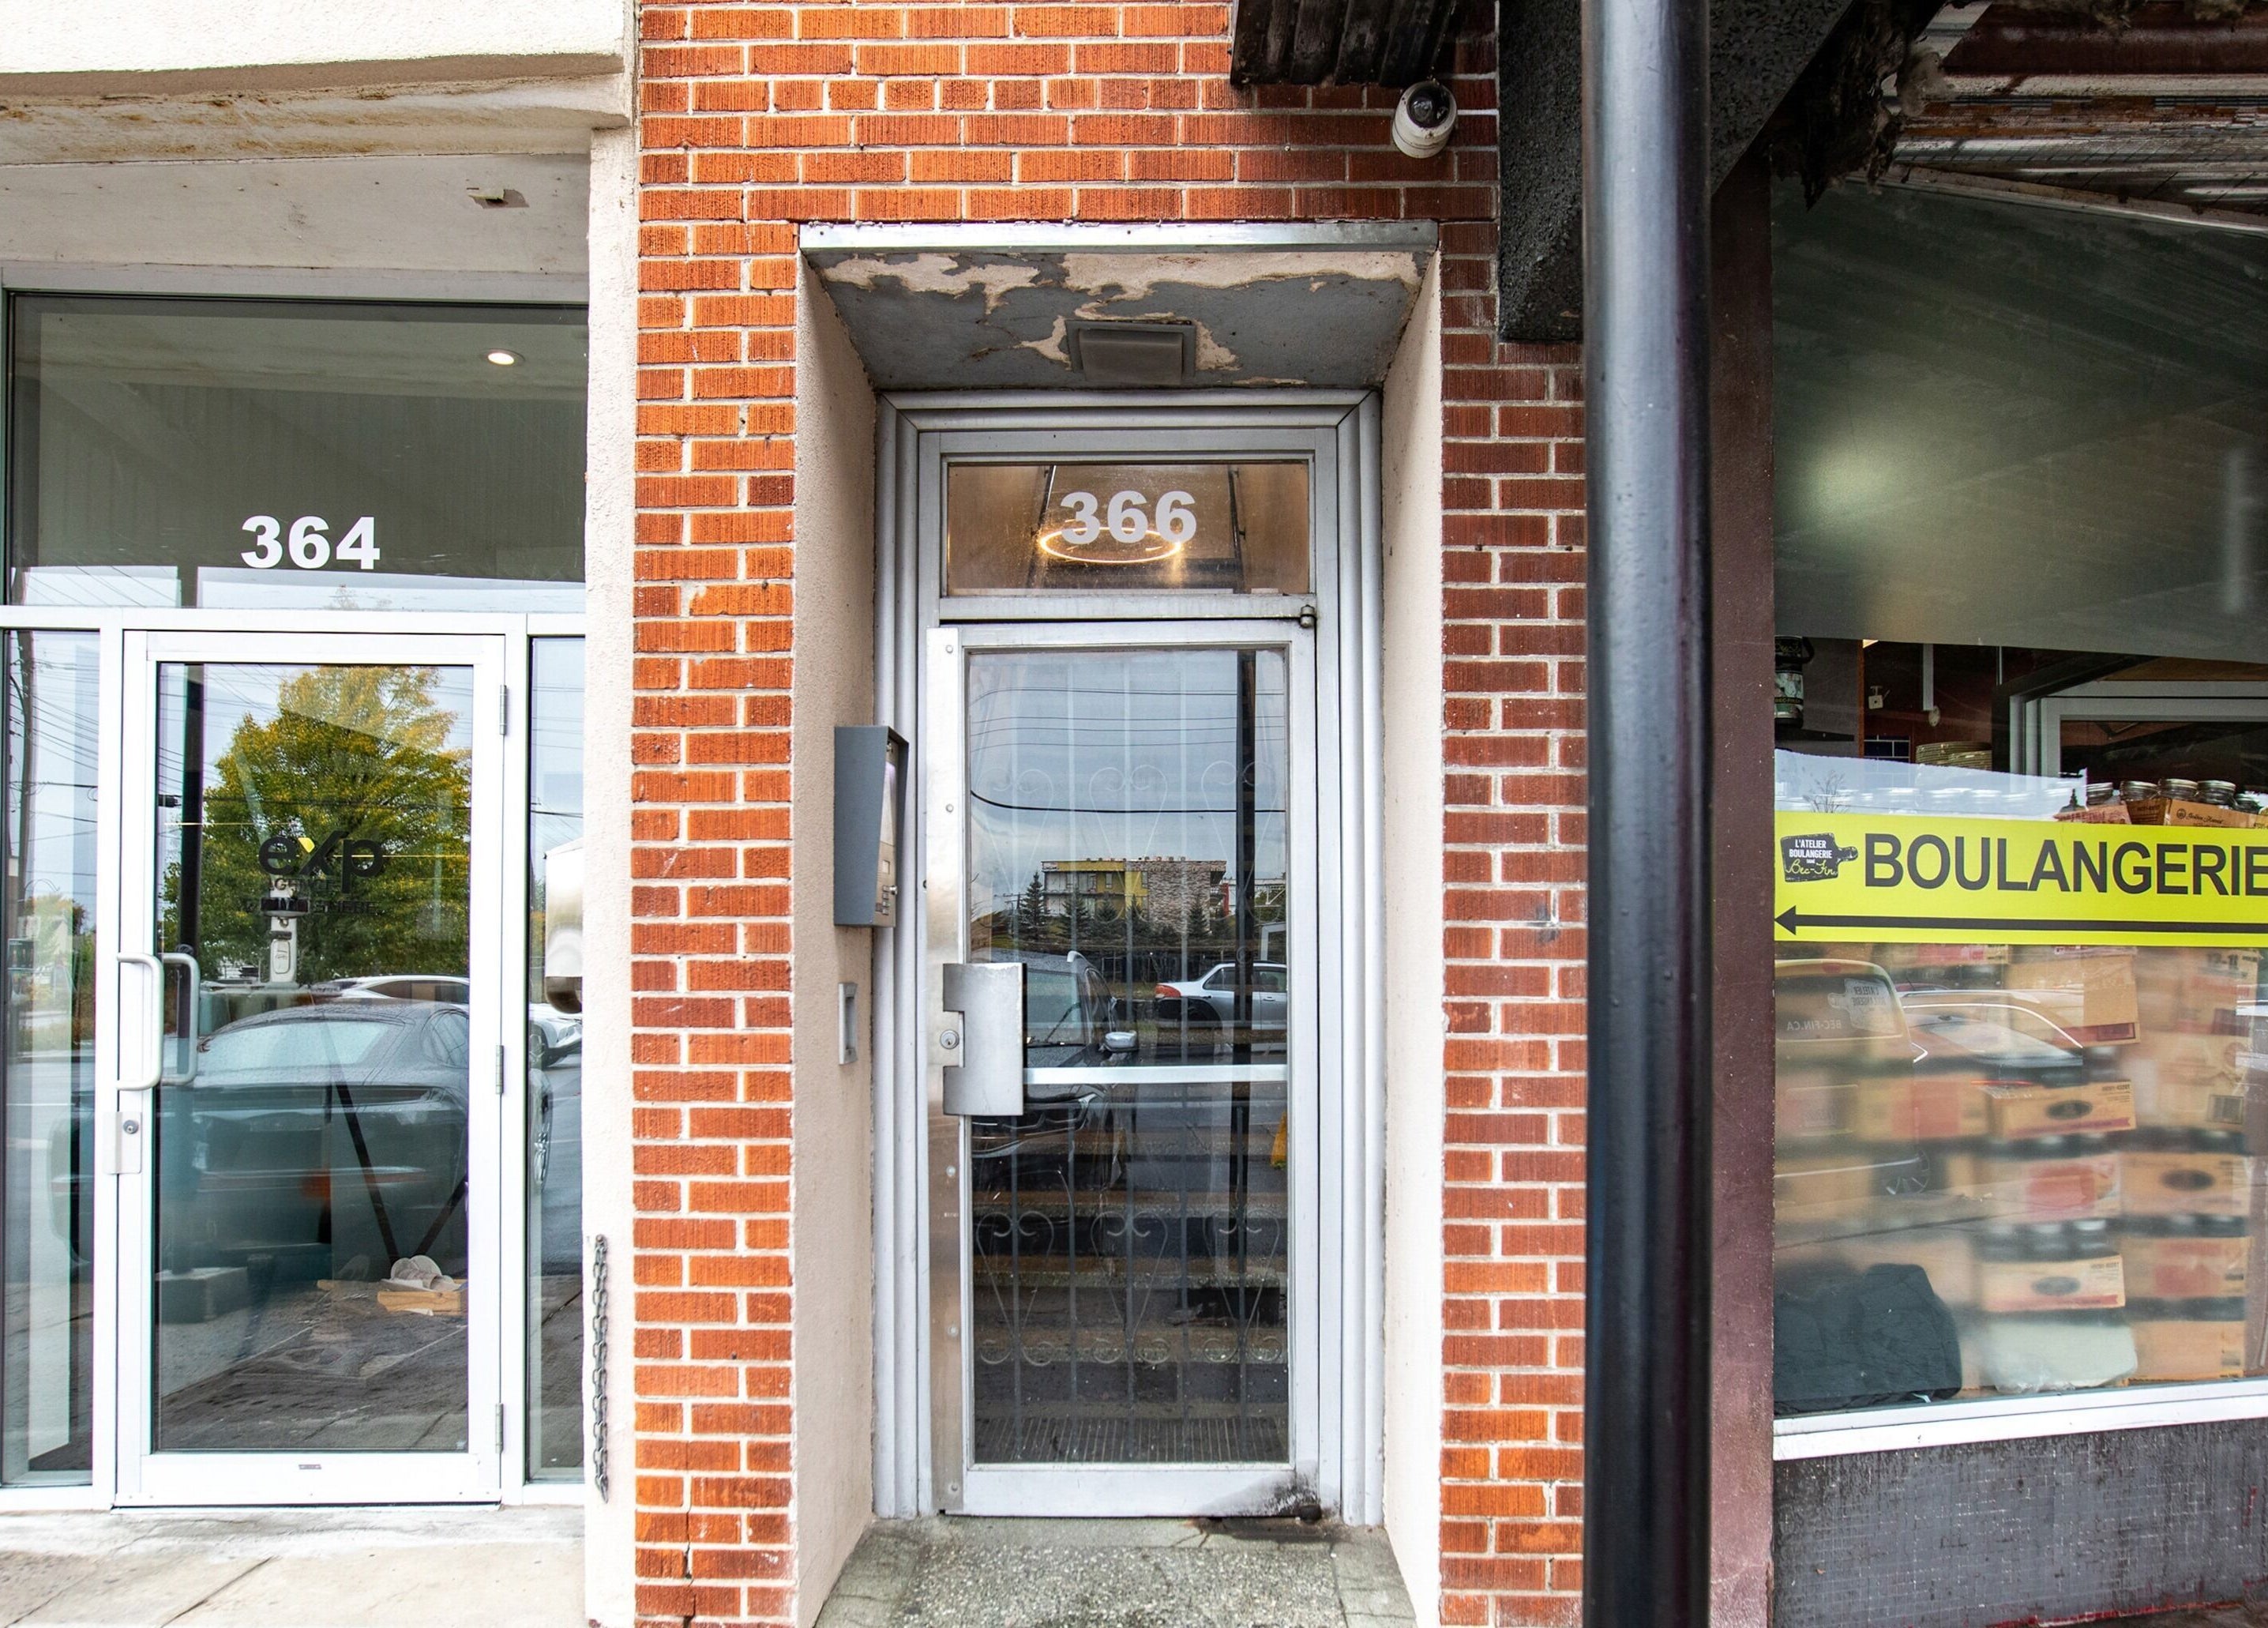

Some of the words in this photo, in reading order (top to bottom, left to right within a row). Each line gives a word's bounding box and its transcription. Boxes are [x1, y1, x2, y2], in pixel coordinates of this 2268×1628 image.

[241, 515, 380, 570] 364
[1060, 491, 1197, 544] 366
[1789, 849, 1833, 859] BOULANGERIE
[1795, 839, 1827, 848] L'ATELIER
[1864, 833, 2268, 897] BOULANGERIE
